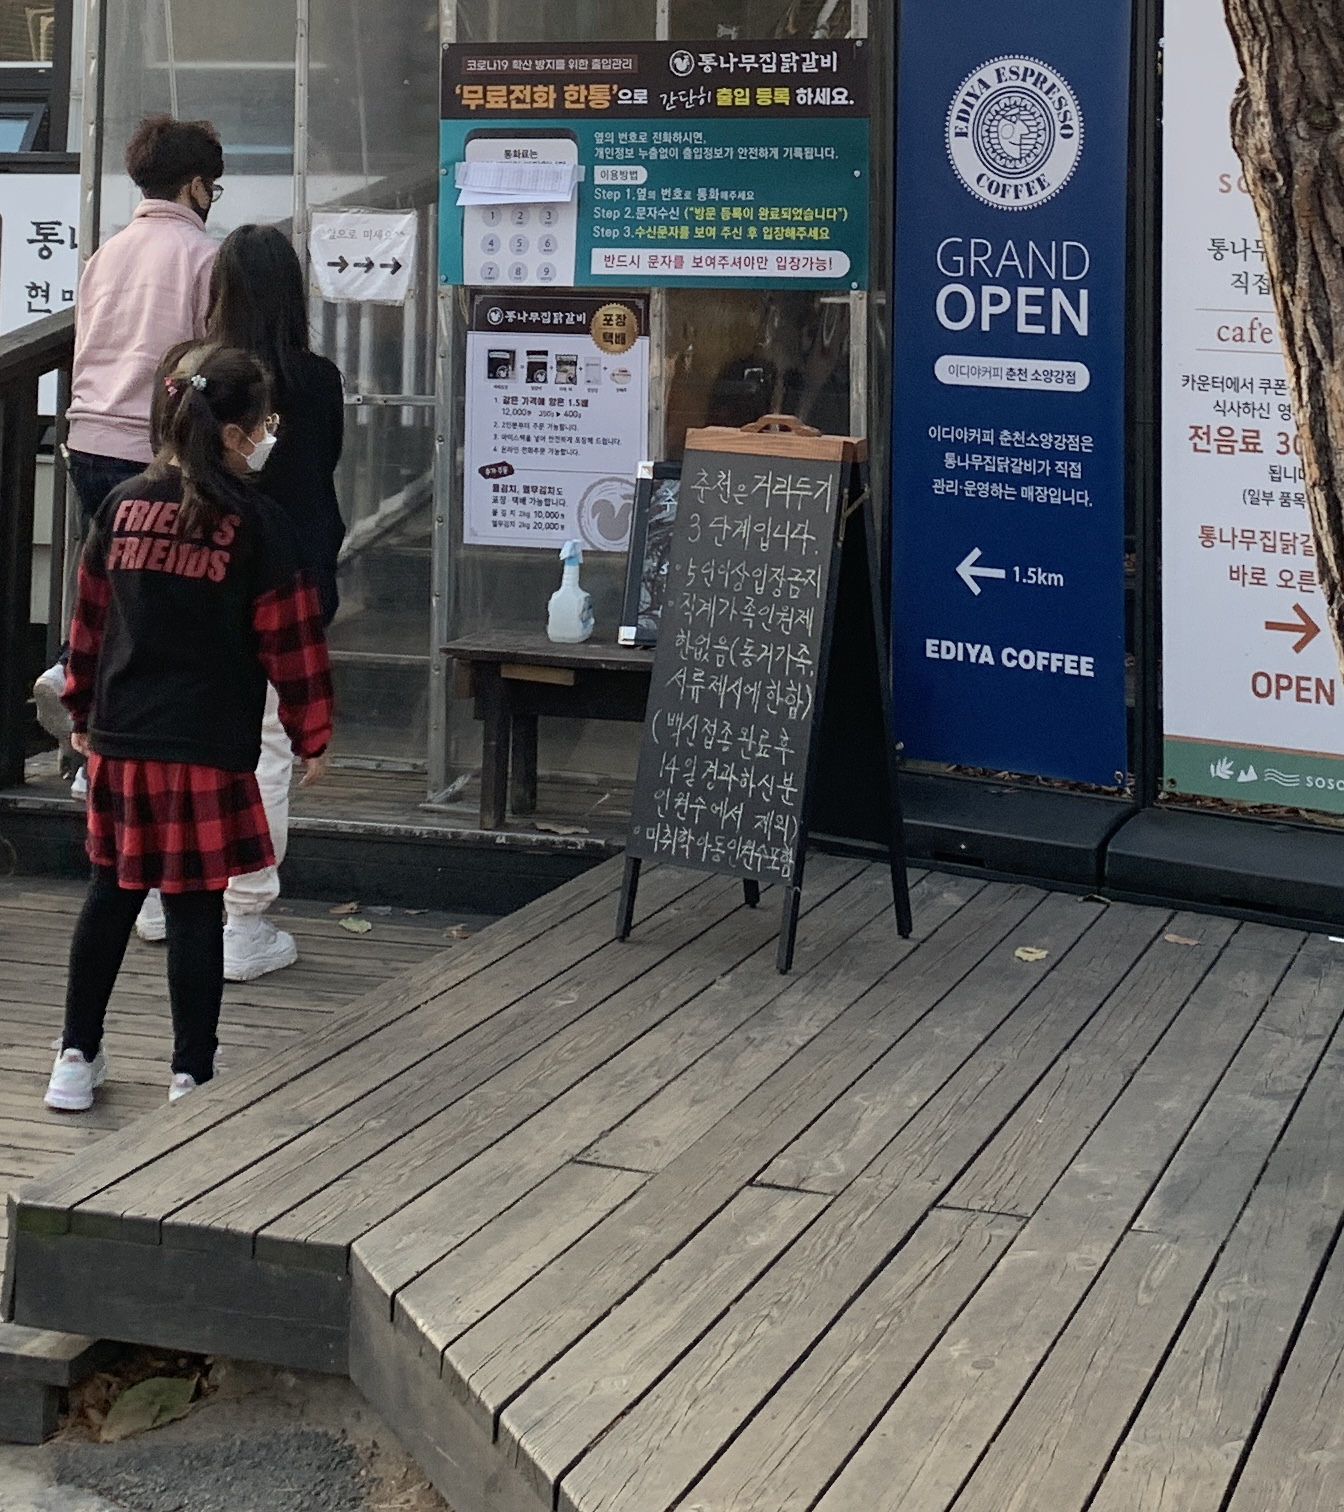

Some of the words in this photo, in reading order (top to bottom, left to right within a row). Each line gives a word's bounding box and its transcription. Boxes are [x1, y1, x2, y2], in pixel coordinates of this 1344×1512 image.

[467, 59, 508, 71] 코로나19
[513, 59, 532, 71] 확산
[535, 59, 565, 71] 방지를
[568, 59, 589, 70] 위한
[591, 58, 632, 70] 출입관리
[697, 51, 838, 73] 통나무집닭갈비
[660, 86, 711, 110] 간단히
[716, 88, 750, 106] 출입
[756, 87, 790, 106] 등록
[795, 88, 855, 106] 하세요.
[954, 77, 991, 139] EDIYA
[994, 64, 1075, 140] ESPRESSO
[594, 132, 614, 144] 옆의
[618, 132, 647, 144] 번호로
[653, 132, 706, 144] 전화하시면,
[594, 147, 634, 160] 개인정보
[682, 147, 734, 160] 출입정보가
[737, 147, 779, 160] 안전하게
[600, 170, 638, 181] 이용방법
[594, 189, 621, 201] Step
[661, 188, 692, 201] 번호로
[975, 172, 1052, 201] COFFEE
[490, 211, 495, 220] 1
[517, 211, 524, 220] 2
[546, 211, 552, 220] 3
[594, 207, 621, 220] Step
[721, 207, 754, 220] 등록이
[488, 239, 494, 248] 4
[516, 239, 522, 248] 5
[545, 239, 551, 248] 6
[593, 226, 620, 239] Step
[694, 226, 717, 239] 보여
[720, 226, 742, 239] 주신
[747, 226, 758, 239] 후
[762, 226, 830, 240] 입장해주세요
[604, 254, 641, 269] 반드시
[648, 255, 684, 269] 문자를
[691, 255, 769, 270] 보여주셔야만
[775, 256, 833, 271] 입장가능!
[937, 237, 1090, 281] GRAND
[487, 267, 494, 276] 7
[515, 267, 521, 276] 8
[544, 267, 550, 276] 9
[602, 313, 627, 327] 포장
[936, 283, 1089, 336] OPEN
[602, 332, 626, 345] 택배
[948, 364, 1003, 380] 이디야커피
[1005, 367, 1028, 382] 춘천
[1030, 369, 1076, 385] 소양강점
[1181, 374, 1254, 394] 카운터에서
[1213, 399, 1271, 420] 식사하신
[928, 425, 994, 445] 이디야커피
[999, 429, 1094, 453] 춘천소양강점은
[1188, 425, 1264, 456] 전음료
[944, 452, 1051, 476] 통나무집닭갈비가
[1055, 460, 1082, 479] 직접
[1021, 486, 1093, 507] 매장입니다.
[1243, 488, 1275, 506] (일부
[113, 499, 241, 546] FRIES
[107, 536, 231, 583] FRIENDS
[1013, 565, 1064, 587] 1.5km
[1229, 565, 1268, 587] 바로
[925, 638, 995, 666] EDIYA
[1001, 647, 1095, 678] COFFEE
[1251, 671, 1335, 706] OPEN
